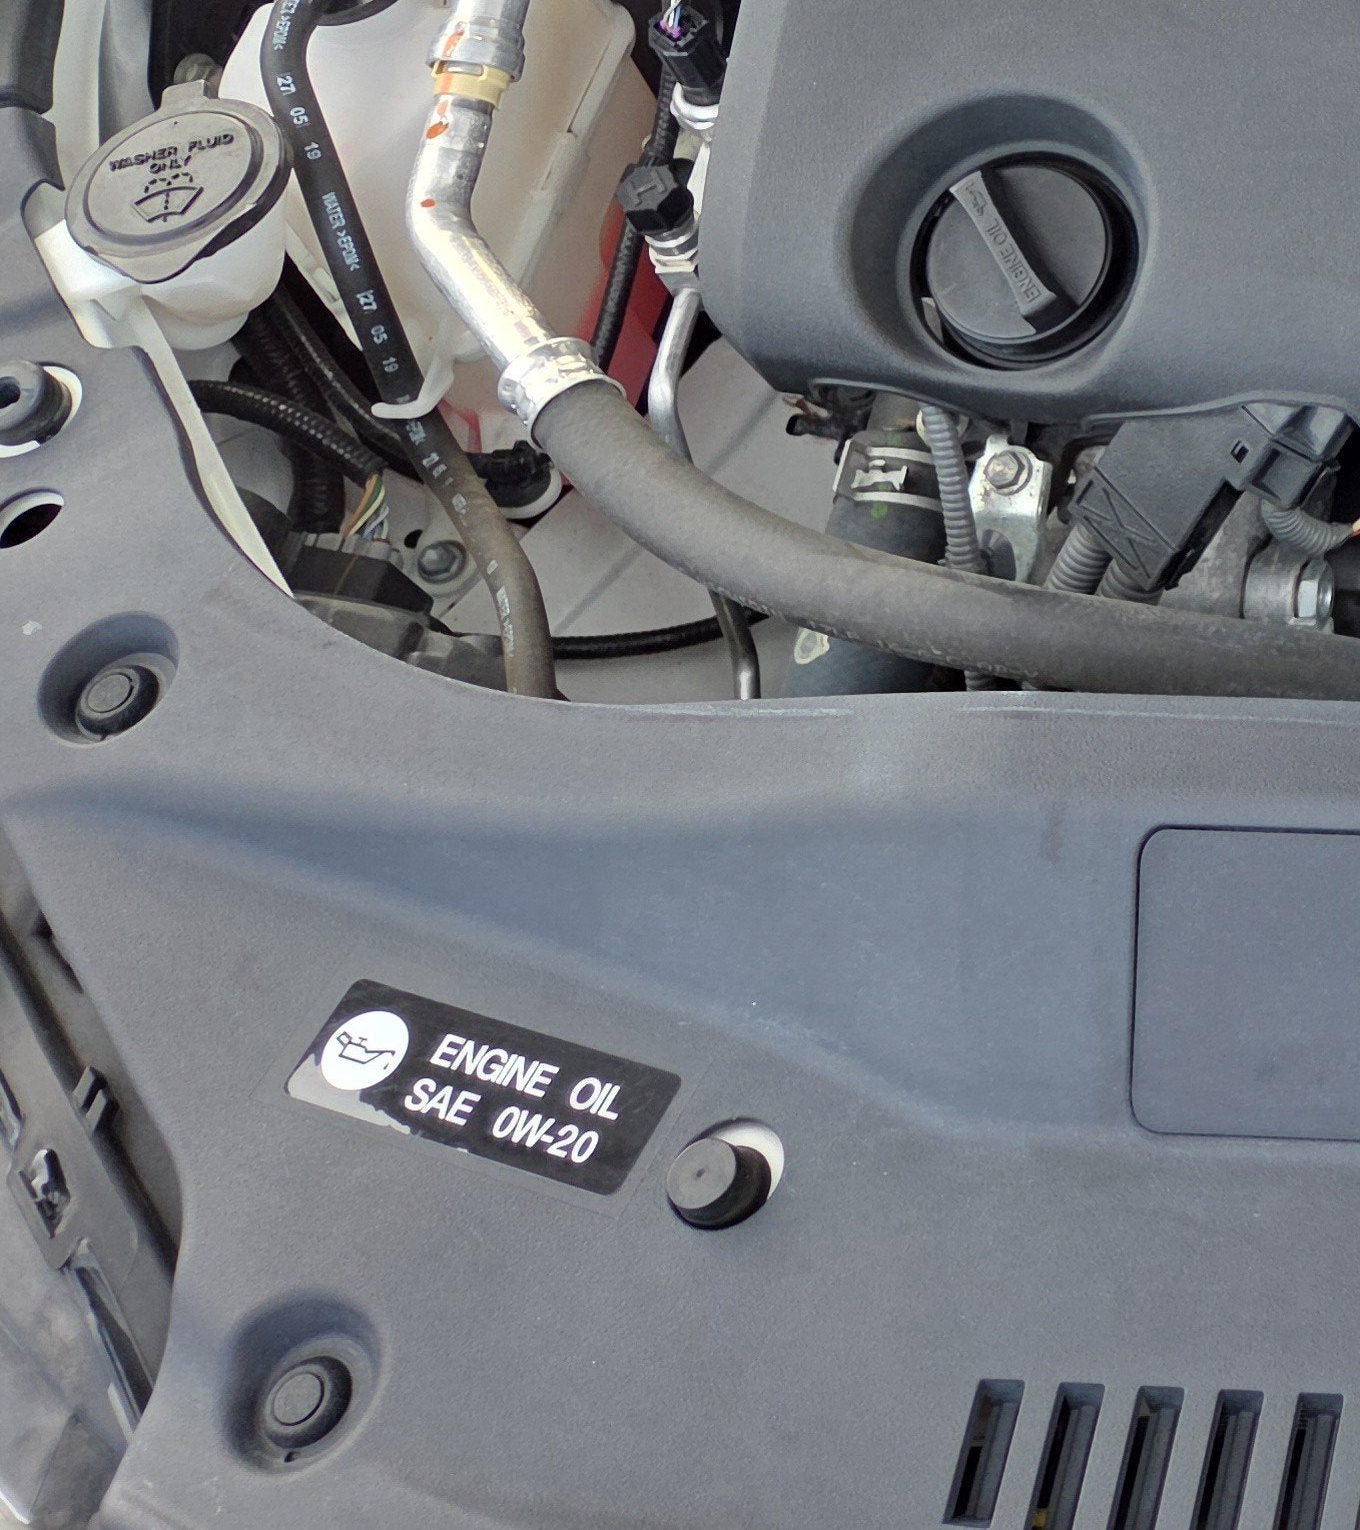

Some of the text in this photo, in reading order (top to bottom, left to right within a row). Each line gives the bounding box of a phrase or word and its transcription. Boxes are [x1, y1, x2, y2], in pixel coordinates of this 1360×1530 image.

[109, 133, 234, 173] WASHER FLUID
[150, 155, 192, 174] ONLY
[986, 217, 1042, 304] ENGINE OIL
[429, 1034, 620, 1121] ENGINE OIL
[404, 1079, 599, 1164] SAE 0W-20
